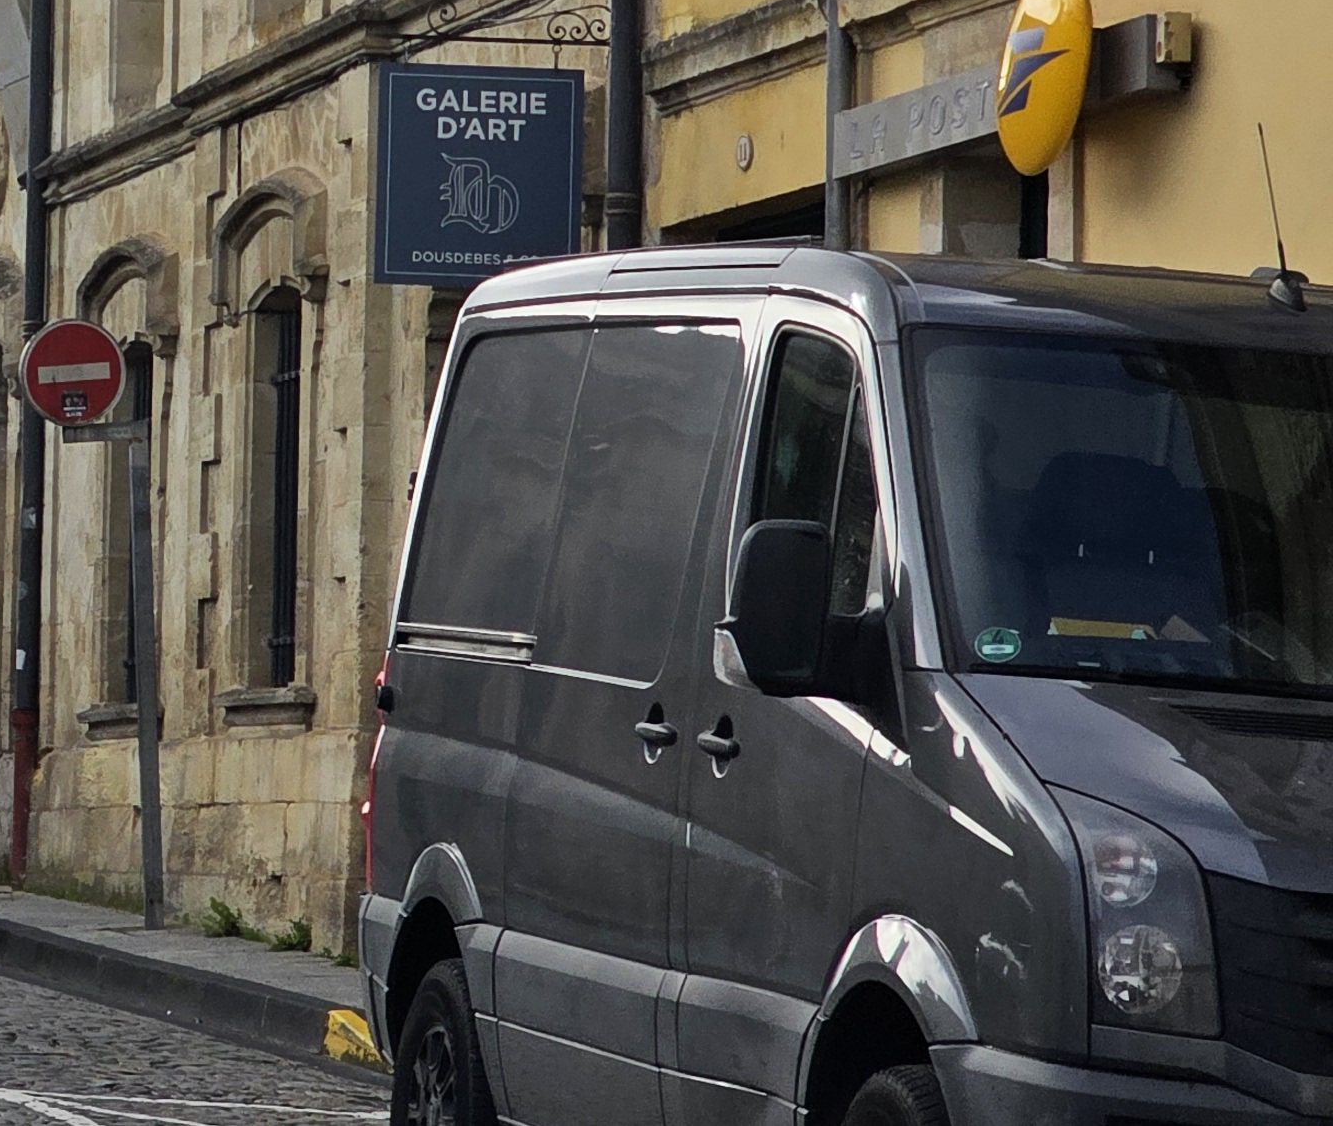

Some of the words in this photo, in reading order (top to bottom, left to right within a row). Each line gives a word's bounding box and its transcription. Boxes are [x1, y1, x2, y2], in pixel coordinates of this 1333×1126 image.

[416, 87, 547, 115] GALERIE
[846, 113, 888, 160] LA
[906, 79, 993, 144] POST
[411, 250, 502, 266] DOUSDEBES
